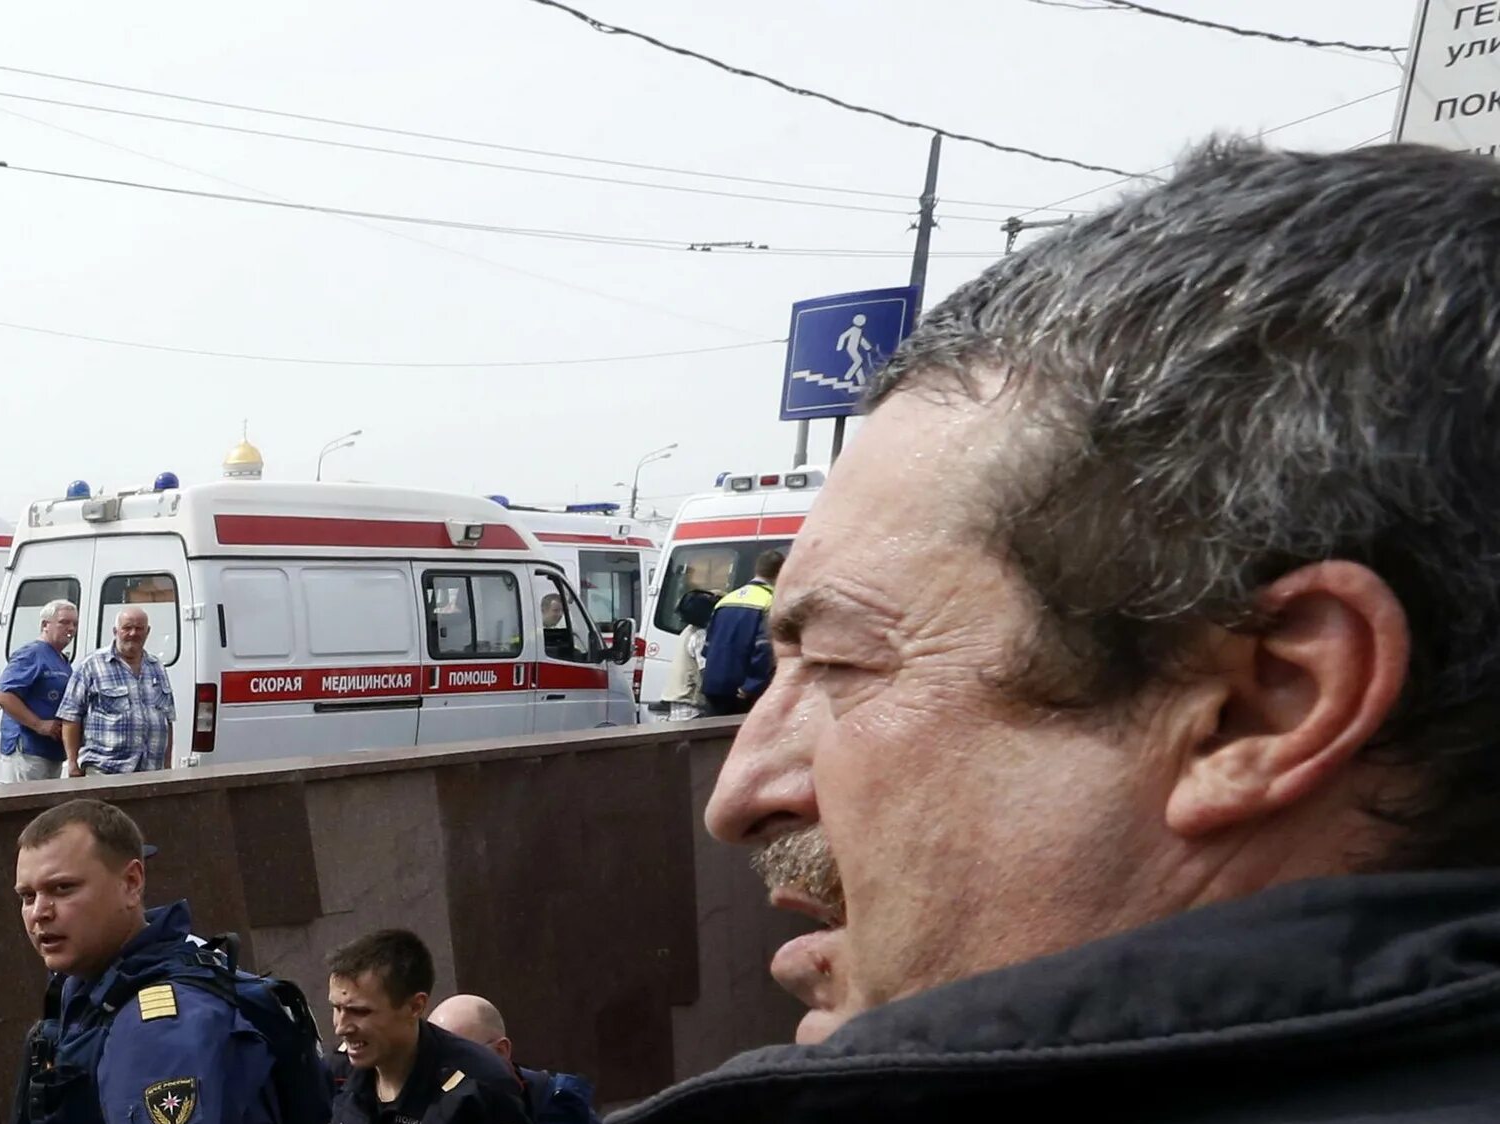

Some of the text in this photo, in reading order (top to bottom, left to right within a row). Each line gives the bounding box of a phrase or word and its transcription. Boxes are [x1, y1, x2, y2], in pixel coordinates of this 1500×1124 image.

[1454, 1, 1500, 31] ГЕ
[250, 670, 498, 693] СКОРАЯ МЕДИЦИНСКАЯ ПОМОЩЬ
